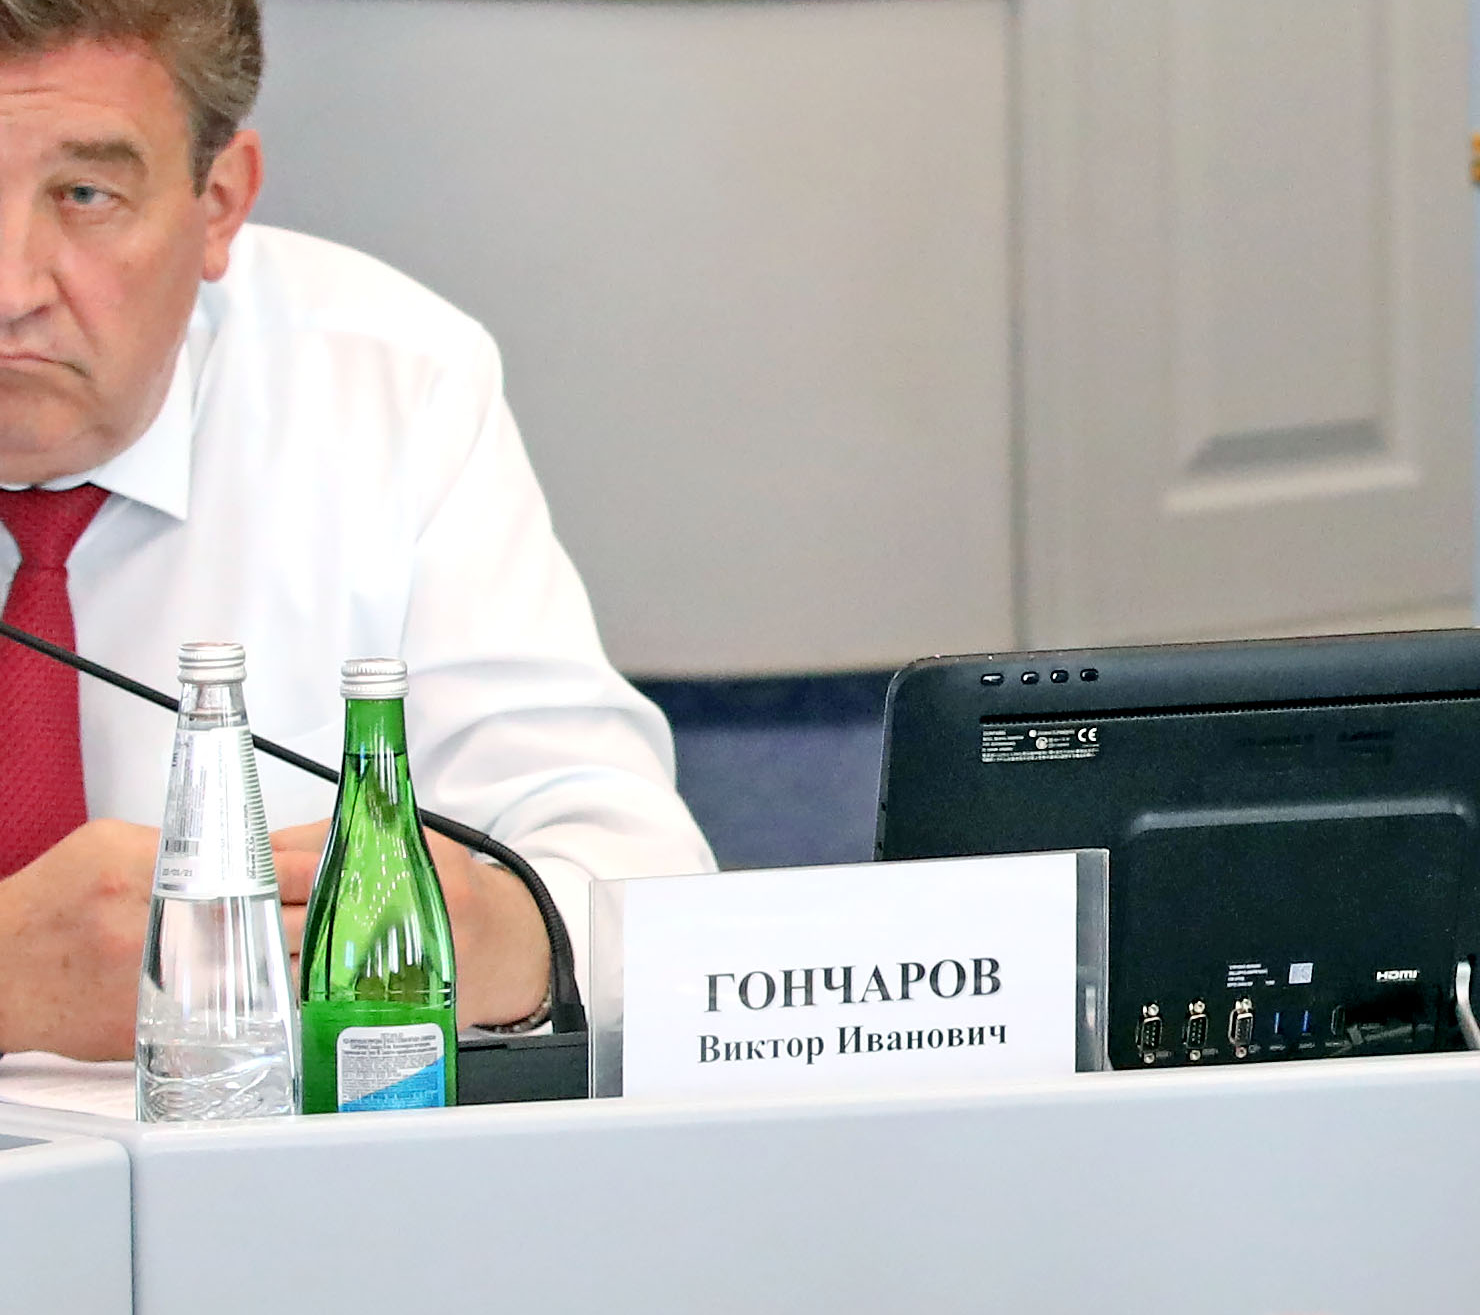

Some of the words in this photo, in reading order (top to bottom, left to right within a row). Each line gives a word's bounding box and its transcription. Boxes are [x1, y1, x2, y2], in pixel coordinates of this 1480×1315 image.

[1077, 727, 1098, 742] CE
[704, 956, 1002, 1013] ГОНЧАРОВ
[697, 1034, 824, 1065] Виктор
[837, 1025, 1007, 1055] Иванович
